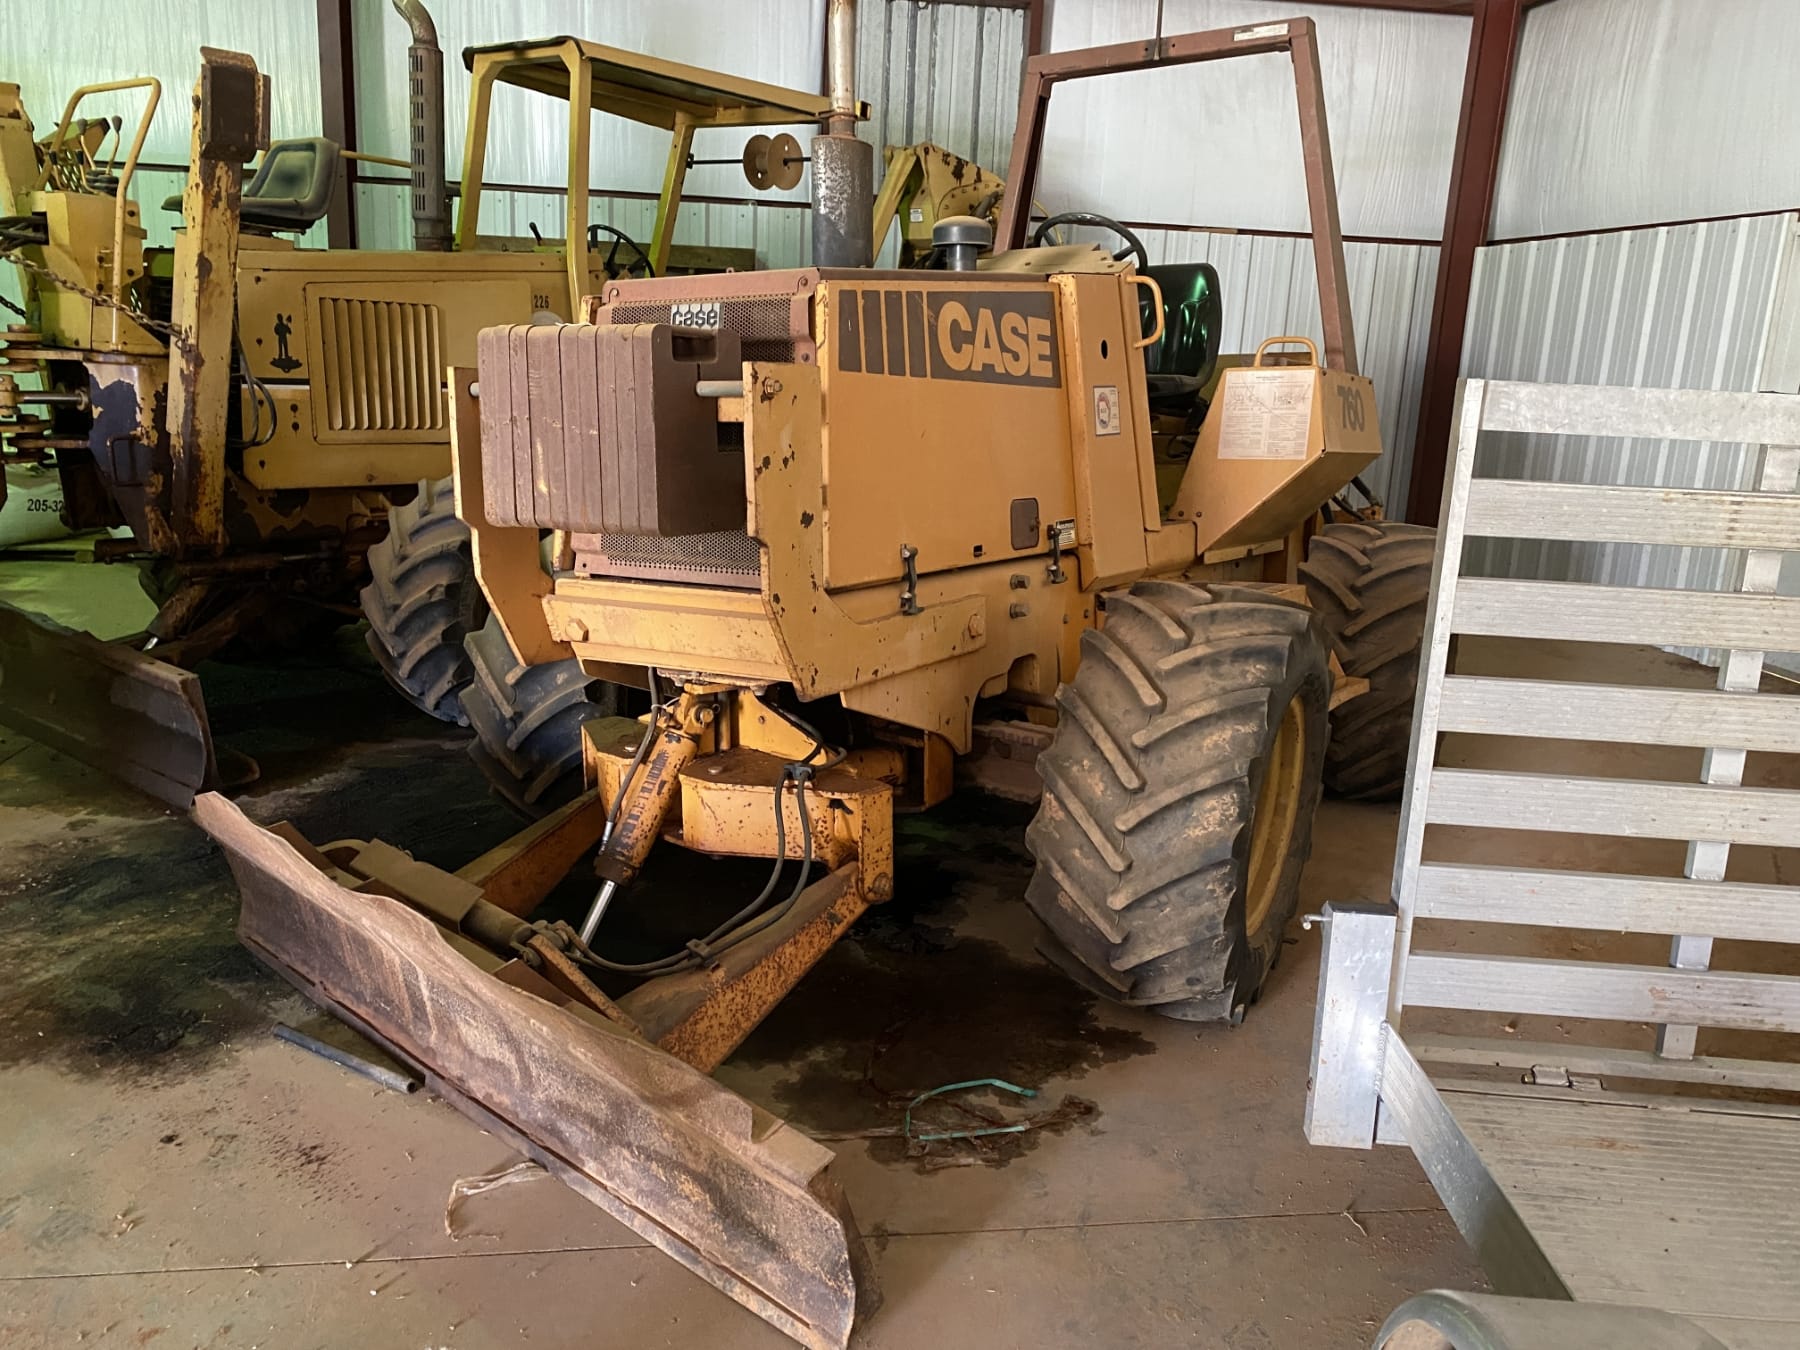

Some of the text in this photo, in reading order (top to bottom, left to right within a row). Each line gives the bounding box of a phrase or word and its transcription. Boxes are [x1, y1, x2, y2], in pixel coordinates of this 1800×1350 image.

[672, 307, 718, 328] case
[937, 301, 1053, 377] CASE
[1337, 384, 1365, 432] 760
